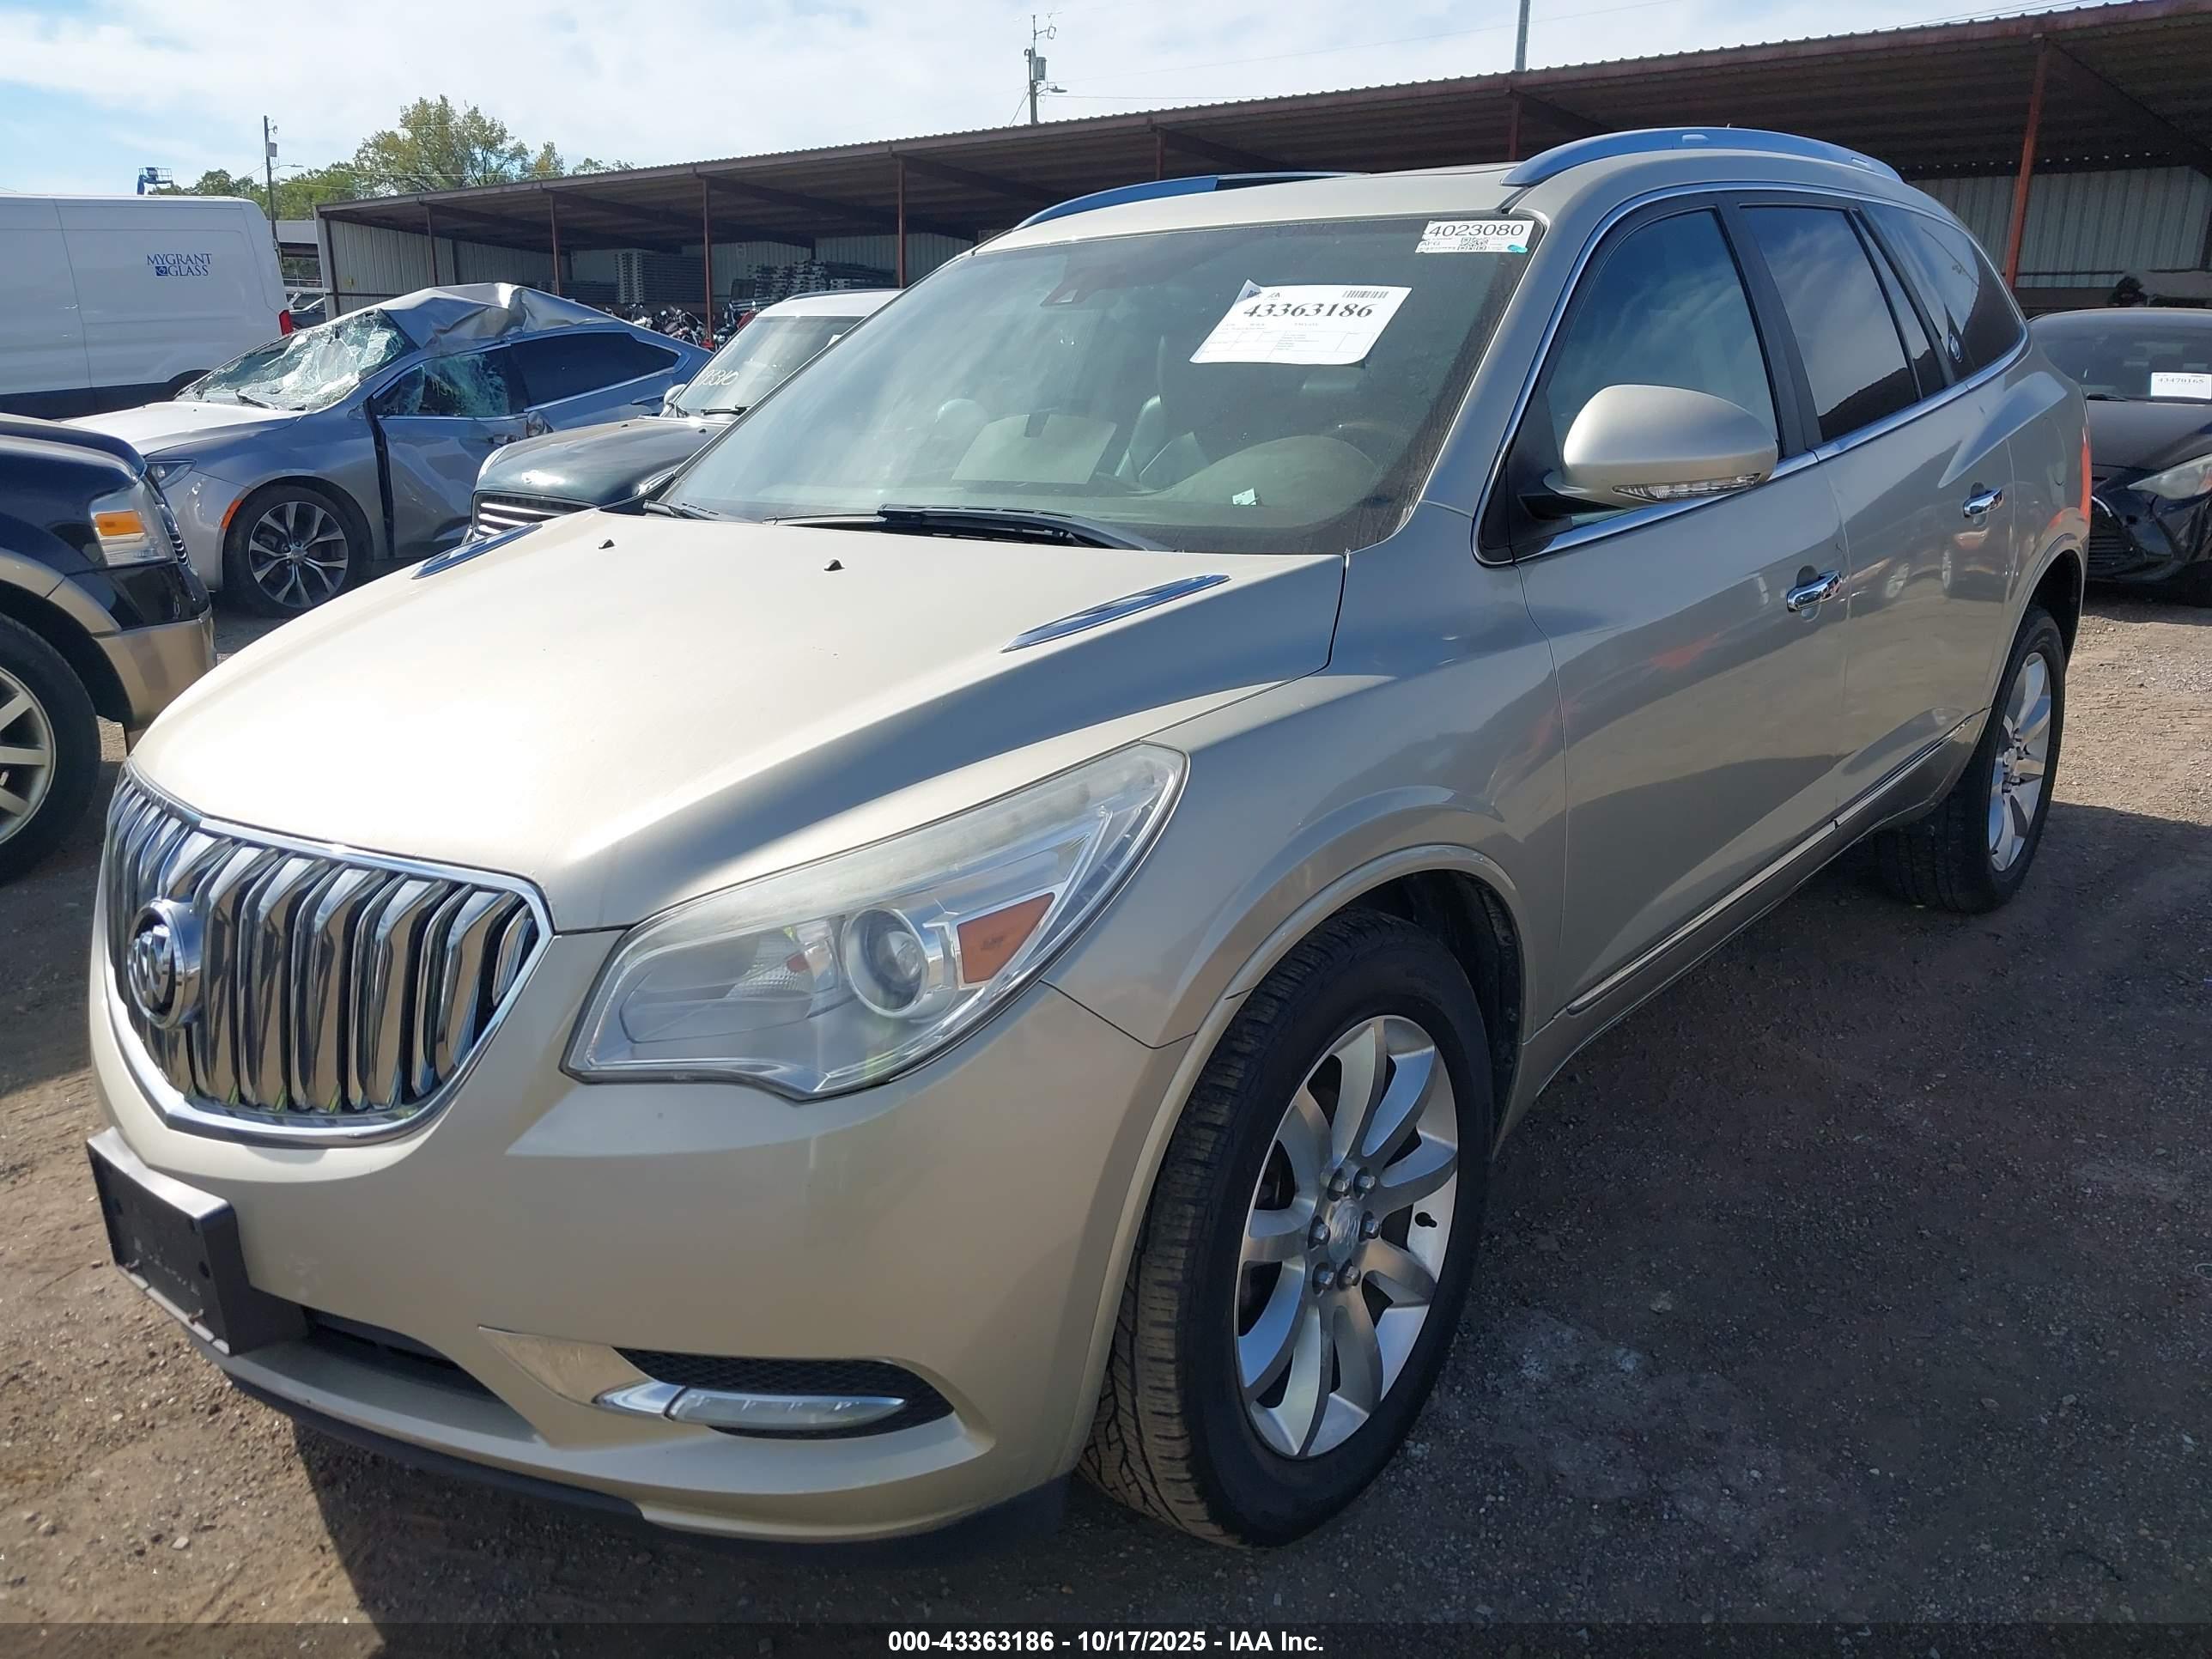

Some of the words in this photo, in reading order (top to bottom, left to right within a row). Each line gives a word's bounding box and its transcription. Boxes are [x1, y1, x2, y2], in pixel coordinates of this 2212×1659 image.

[1429, 223, 1524, 236] 4023080
[147, 253, 212, 265] MYGRANT
[167, 264, 209, 276] GLASS
[1243, 302, 1381, 318] 43363186
